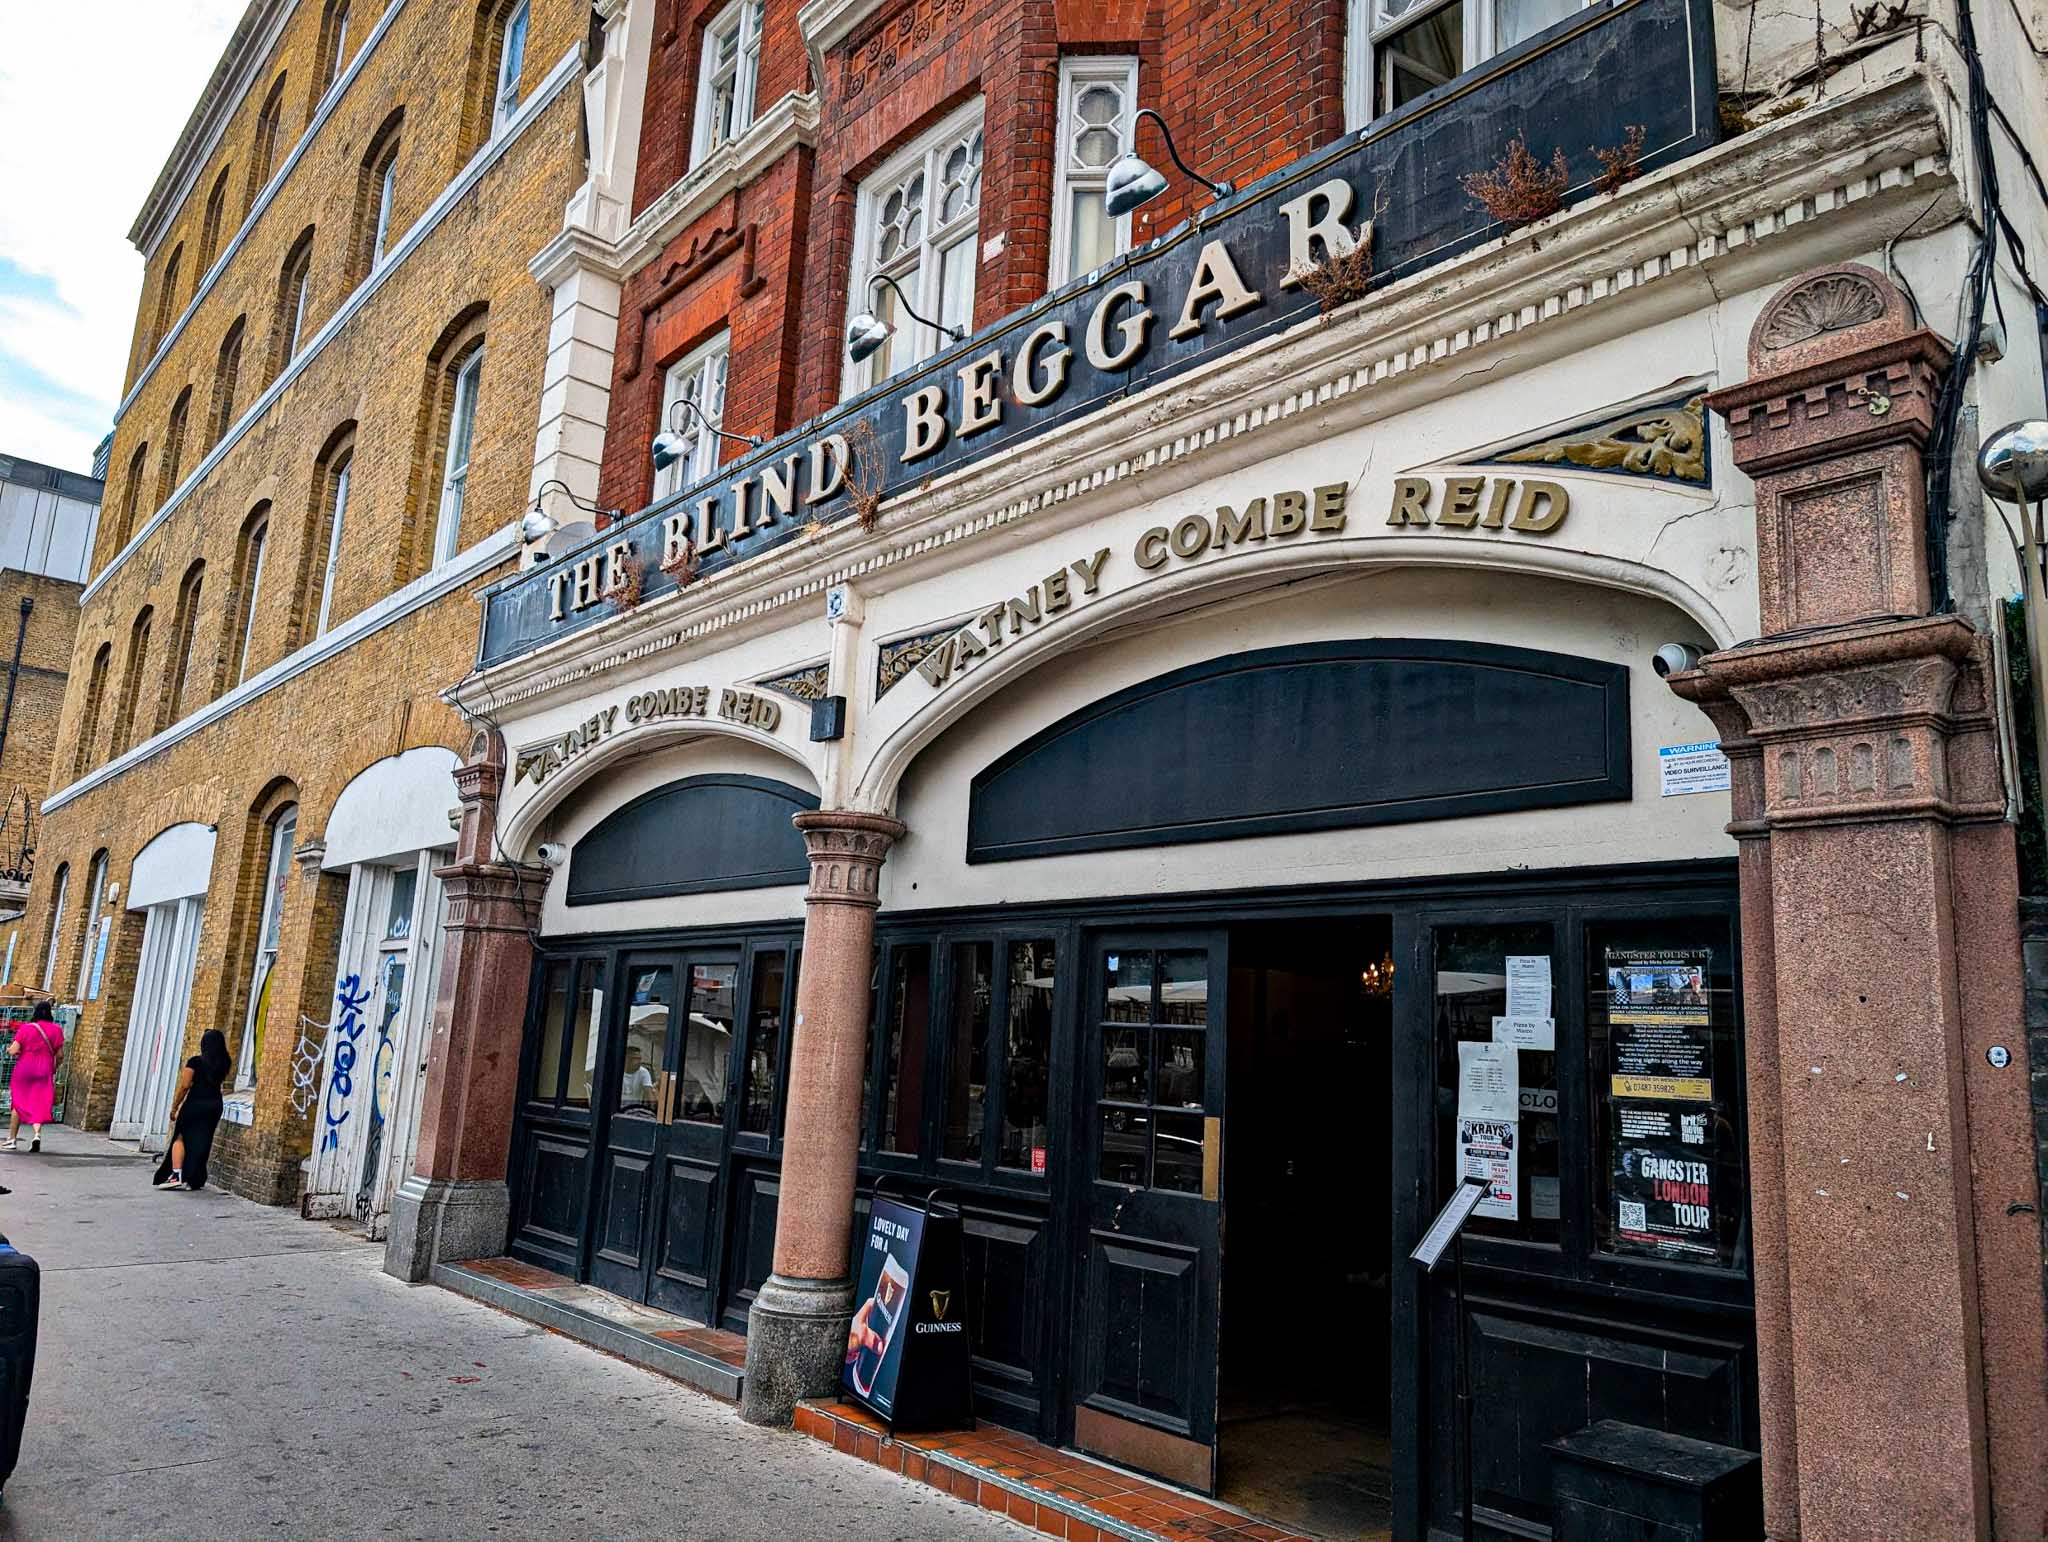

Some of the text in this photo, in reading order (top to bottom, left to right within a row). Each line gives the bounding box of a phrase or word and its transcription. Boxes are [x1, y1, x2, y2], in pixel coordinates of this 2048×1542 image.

[548, 177, 1373, 622] THE BLIND BEGGAR
[915, 475, 1570, 688] WATNEY COMBE REID
[527, 686, 780, 784] WATNEY COMBE REID
[1684, 764, 1728, 774] SURVEILLANCE
[1608, 951, 1656, 959] GANGSTER
[1520, 1093, 1557, 1109] CLO
[1681, 1114, 1697, 1125] brit
[1472, 1123, 1504, 1137] KRAYS
[1682, 1126, 1704, 1134] movie
[1682, 1134, 1704, 1144] tours
[1641, 1157, 1708, 1184] GANGSTER
[1654, 1179, 1709, 1206] LONDON
[1673, 1203, 1709, 1229] TOUR
[874, 1216, 910, 1242] LOVELY DAY
[871, 1235, 888, 1253] FOR A
[916, 1322, 962, 1333] GUINNESS
